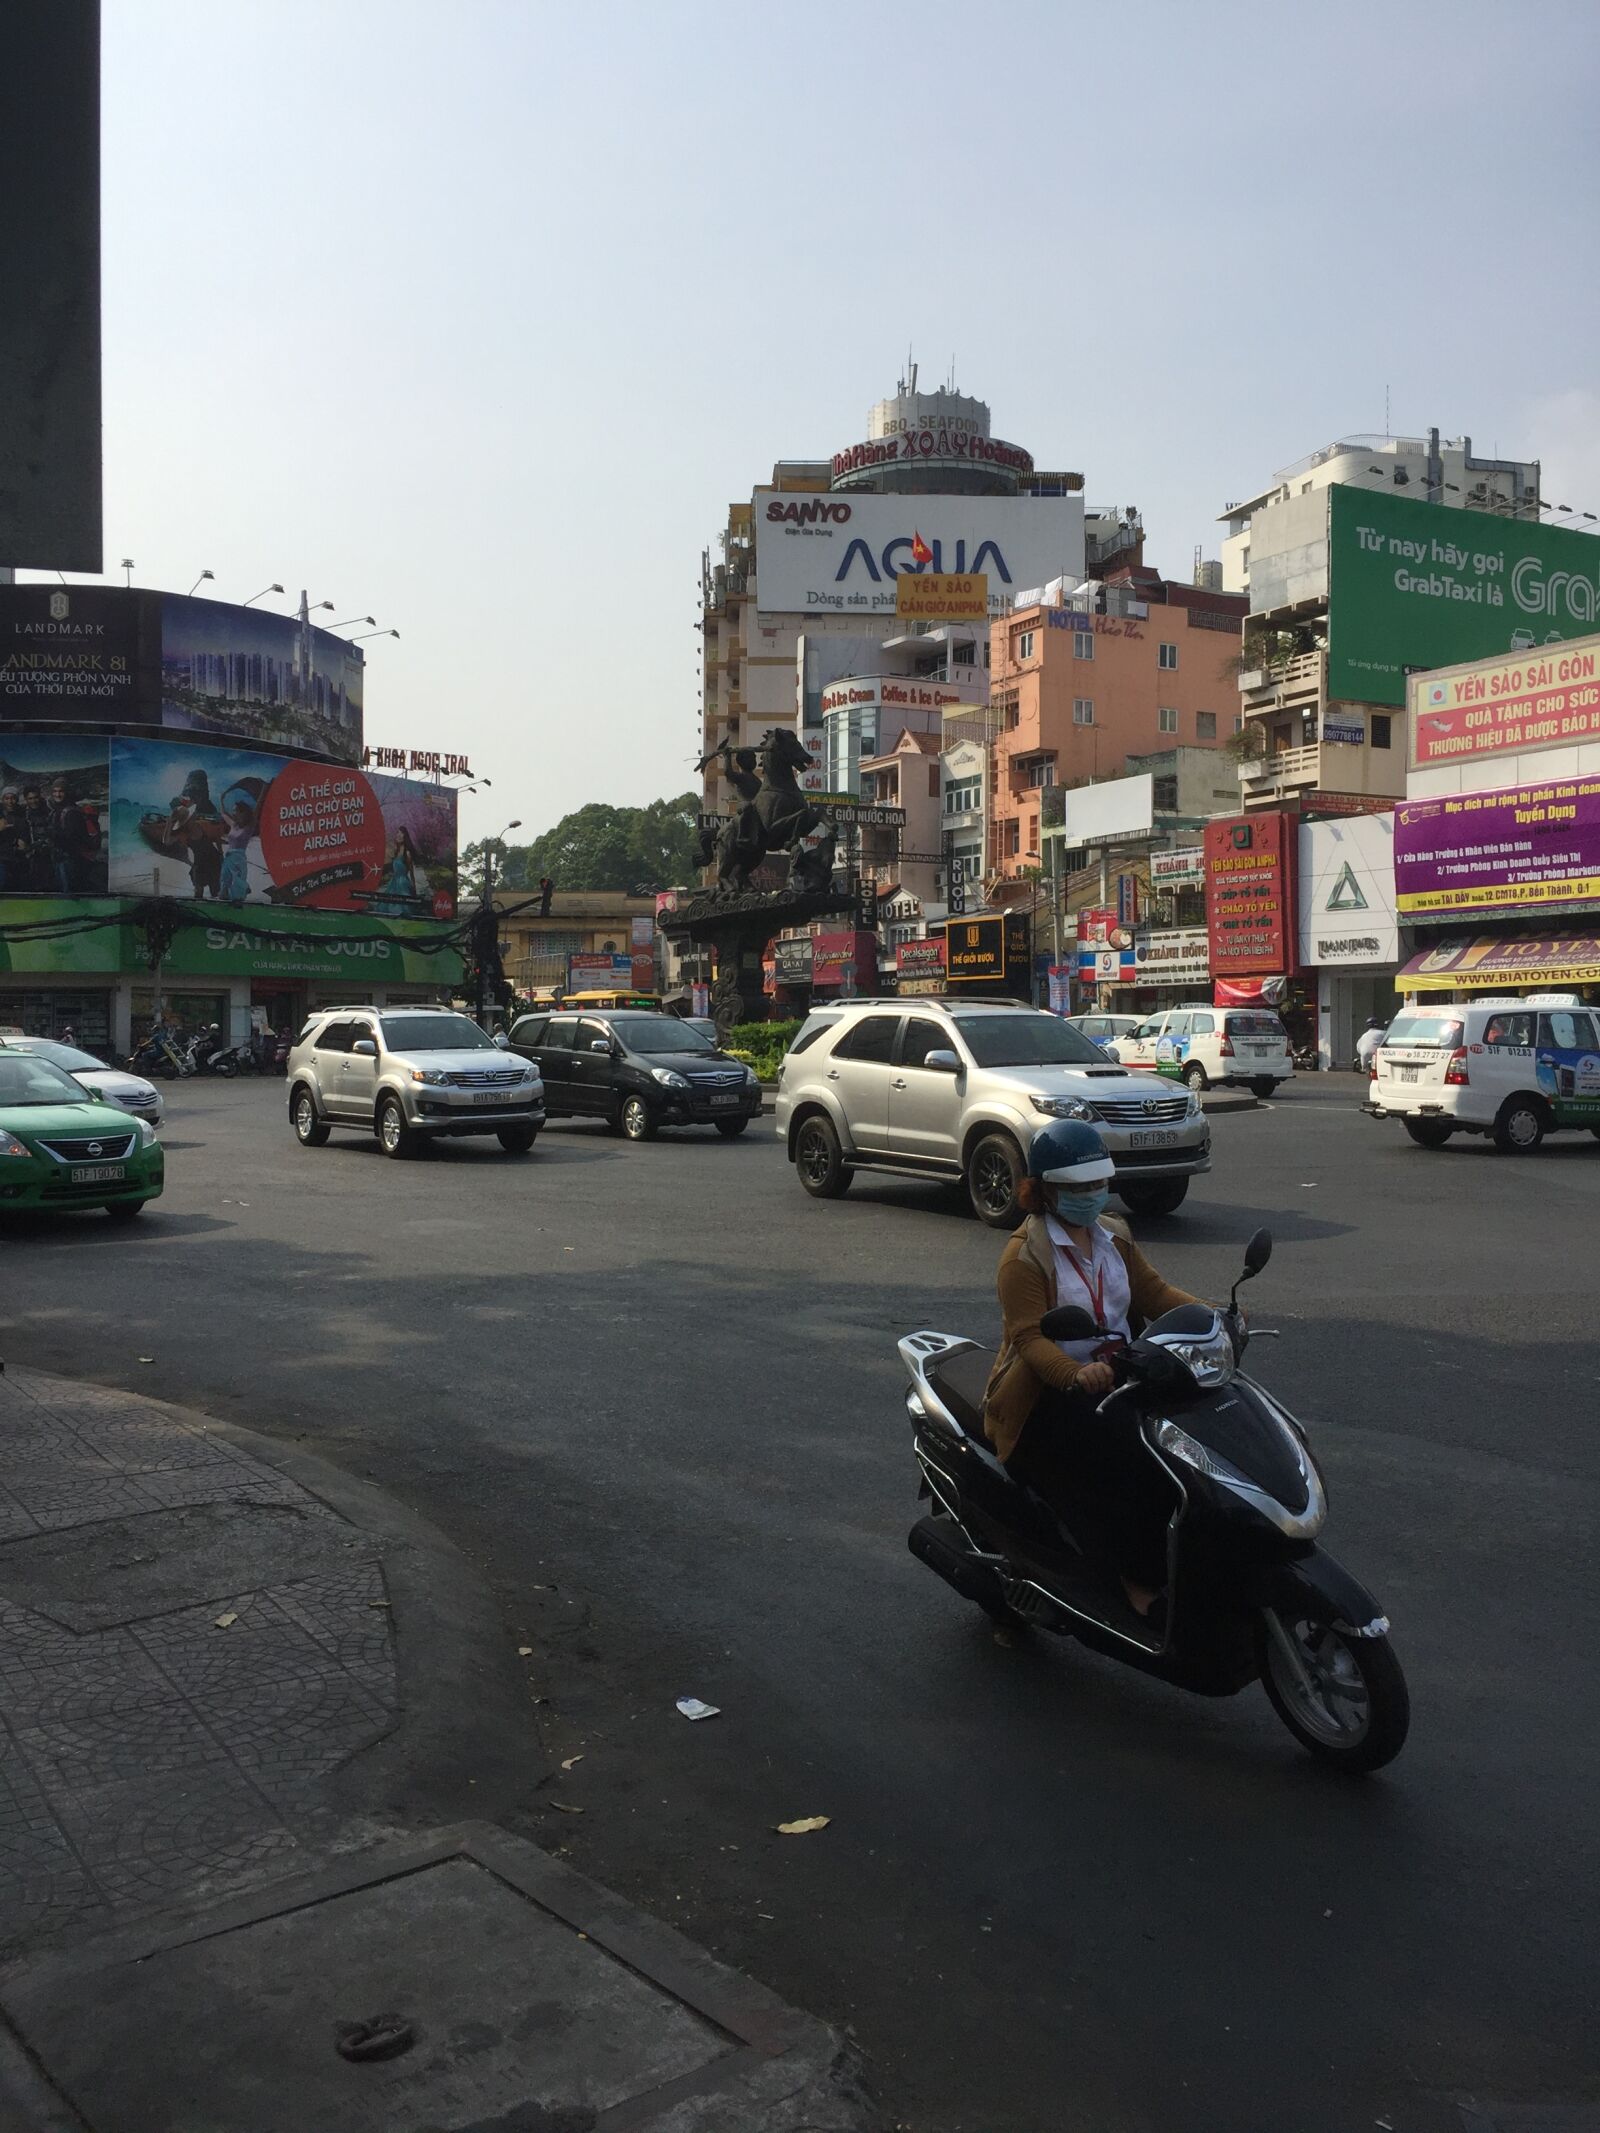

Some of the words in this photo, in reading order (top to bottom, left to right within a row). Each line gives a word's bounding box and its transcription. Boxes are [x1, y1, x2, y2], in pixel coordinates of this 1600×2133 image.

[883, 417, 907, 435] BBQ
[919, 416, 978, 434] SEAFOOD
[901, 431, 968, 458] XOAY
[766, 499, 851, 526] SANYO
[802, 527, 814, 536] Gia
[1356, 526, 1385, 551] Từ
[1389, 538, 1427, 564] nay
[1432, 539, 1469, 571] hãy
[1473, 551, 1504, 576] gọi
[835, 538, 1012, 584] AQUA
[913, 577, 938, 593] YẾN
[946, 577, 972, 593] SÀO
[1394, 569, 1482, 603] GrabTaxi
[1487, 582, 1504, 606] là
[1511, 556, 1600, 622] Gra
[806, 591, 844, 608] Dòng
[848, 591, 869, 605] sản
[872, 591, 897, 608] phẩ
[925, 596, 946, 613] GIỜ
[946, 601, 985, 613] ANPHA
[15, 623, 105, 635] LANDMARK
[1048, 609, 1093, 632] HOTEL
[110, 656, 126, 671] 81
[1373, 660, 1390, 672] dụng
[18, 671, 60, 683] TƯỢNG
[63, 670, 97, 683] PHỒN
[100, 673, 131, 685] VINH
[1454, 675, 1486, 703] YẾN
[1491, 668, 1522, 696] SÀO
[1527, 659, 1553, 689] SÀI
[1558, 651, 1594, 682] GÒN
[5, 681, 31, 694] CỦA
[34, 683, 63, 695] THỜI
[91, 684, 114, 696] MỚI
[849, 688, 875, 703] Cream
[881, 686, 908, 702] Coffee
[910, 688, 916, 703] &
[918, 689, 932, 705] Ice
[1465, 707, 1493, 728] QUÀ
[1497, 702, 1532, 725] TẶNG
[1536, 695, 1565, 714] CHO
[1569, 686, 1599, 708] SỨC
[1428, 734, 1472, 756] THƯƠNG
[1476, 727, 1503, 750] HIỆU
[1506, 724, 1521, 743] ĐÃ
[1525, 719, 1558, 740] ĐƯỢC
[1561, 711, 1587, 734] BẢO
[377, 747, 406, 769] KHOA
[411, 750, 439, 774] NGỌC
[444, 753, 468, 774] TRAI
[290, 783, 306, 801] CẢ
[309, 779, 330, 798] THẾ
[333, 778, 356, 795] GIỚI
[280, 803, 312, 820] ĐANG
[315, 797, 340, 814] CHỜ
[342, 796, 364, 812] BẠN
[1445, 801, 1463, 815] Mục
[1464, 797, 1482, 811] đích
[1483, 793, 1497, 808] mở
[1498, 793, 1518, 808] rộng
[1519, 791, 1531, 804] thị
[1556, 785, 1576, 799] Kinh
[835, 806, 855, 821] GIỚI
[858, 808, 883, 824] NƯỚC
[885, 812, 905, 825] HOA
[1515, 803, 1545, 824] Tuyển
[1547, 803, 1576, 822] Dụng
[280, 819, 314, 837] KHÁM
[318, 813, 341, 831] PHÁ
[345, 810, 364, 826] VỚI
[304, 831, 347, 851] AIRASIA
[1404, 850, 1417, 863] Cửa
[1417, 849, 1433, 863] Hàng
[1435, 845, 1458, 860] Trưởng
[1459, 846, 1464, 857] &
[1465, 844, 1482, 857] Nhân
[1483, 842, 1499, 855] Viên
[1500, 841, 1513, 853] Bán
[1514, 840, 1532, 851] Hàng
[1210, 858, 1222, 872] YẾN
[1223, 857, 1234, 871] SÀO
[1234, 855, 1244, 870] SÀI
[1244, 854, 1256, 868] GÒN
[1257, 854, 1277, 867] ANPHA
[1437, 866, 1444, 876] 2/
[1446, 860, 1469, 875] Trưởng
[1470, 859, 1491, 873] Phòng
[1492, 857, 1508, 870] Kinh
[1509, 856, 1531, 869] Doanh
[1552, 852, 1568, 864] Siêu
[1569, 851, 1581, 864] Thị
[1508, 873, 1515, 883] 3/
[1516, 867, 1541, 882] Trưởng
[1543, 867, 1565, 881] Phòng
[951, 859, 964, 912] RƯỢU
[861, 880, 872, 925] HOTEL
[1455, 890, 1469, 903] ĐÂY
[1485, 890, 1493, 900] 12
[877, 900, 917, 919] HOTEL
[1221, 902, 1244, 914] CHÁO
[901, 947, 938, 961] Decalsaigon
[952, 952, 962, 964] THẾ
[963, 951, 976, 963] GIỚI
[1181, 942, 1208, 958] HỒNG
[1455, 967, 1600, 985] WWW.BIATOYEN.CO
[1215, 1399, 1240, 1412] HONDA
